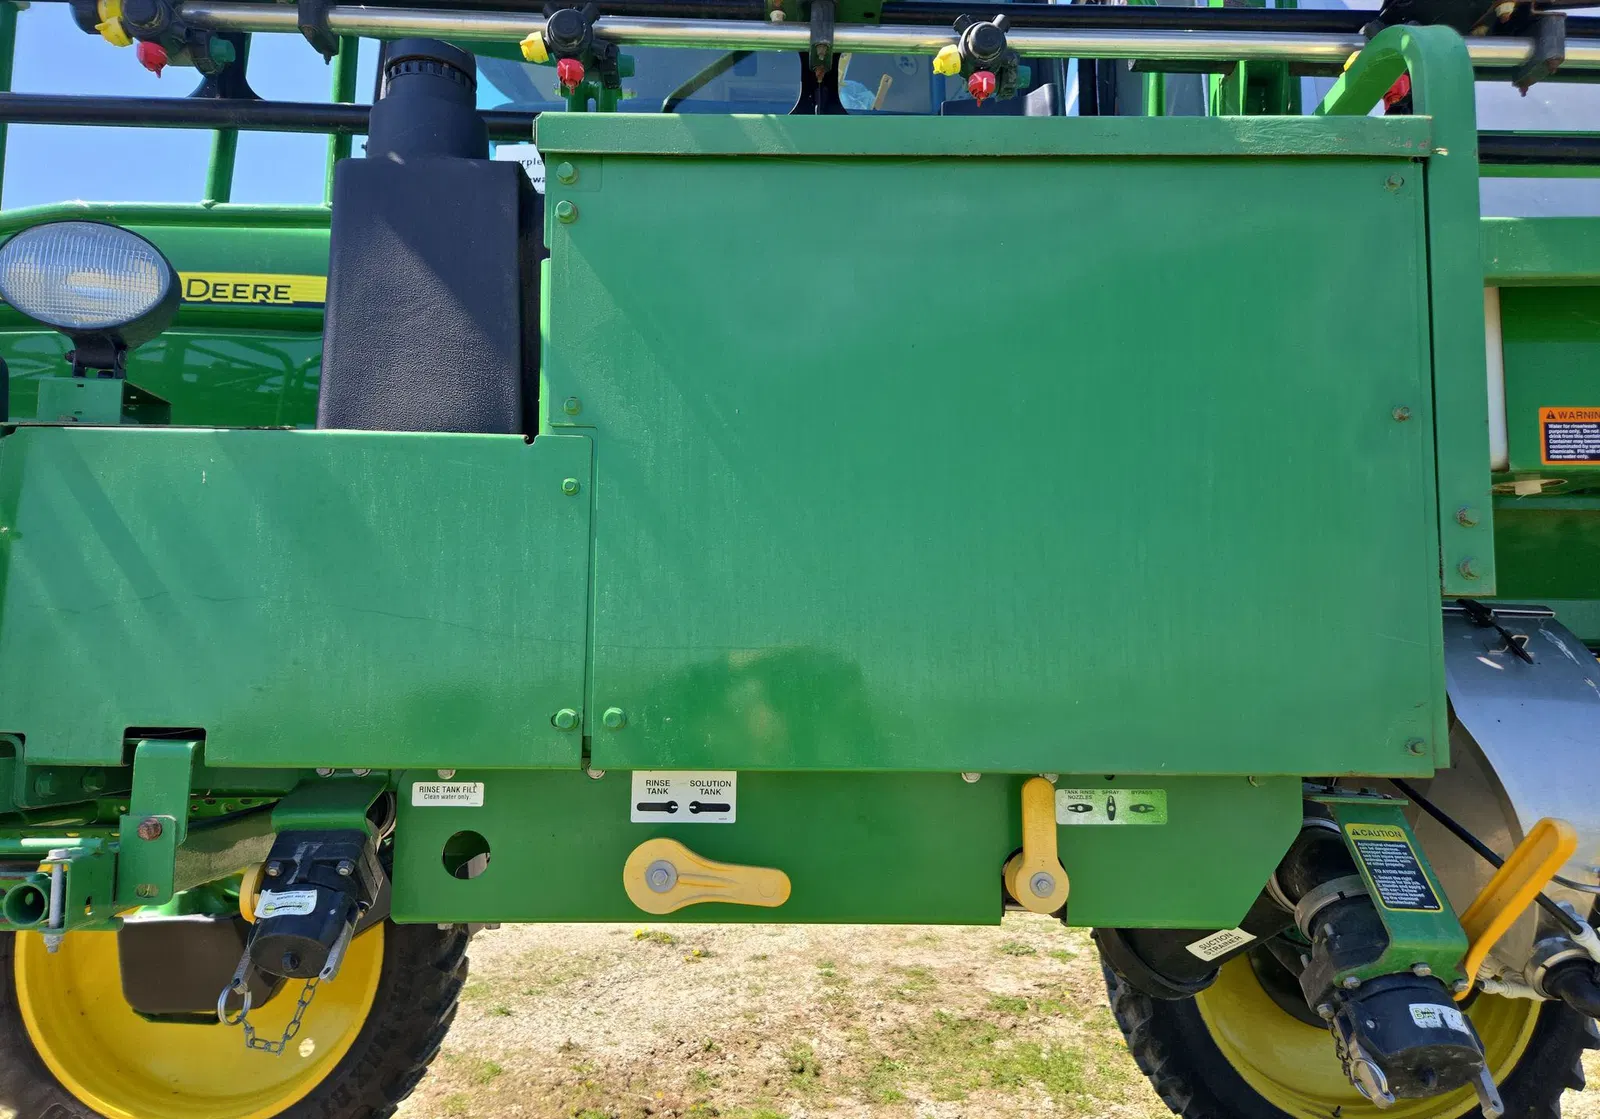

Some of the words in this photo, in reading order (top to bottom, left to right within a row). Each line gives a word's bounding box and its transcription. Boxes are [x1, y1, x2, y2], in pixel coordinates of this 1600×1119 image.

[186, 279, 291, 300] DEERE
[1360, 829, 1402, 838] CAUTION
[1199, 933, 1233, 950] SUCTION
[1204, 936, 1242, 955] STRAINER
